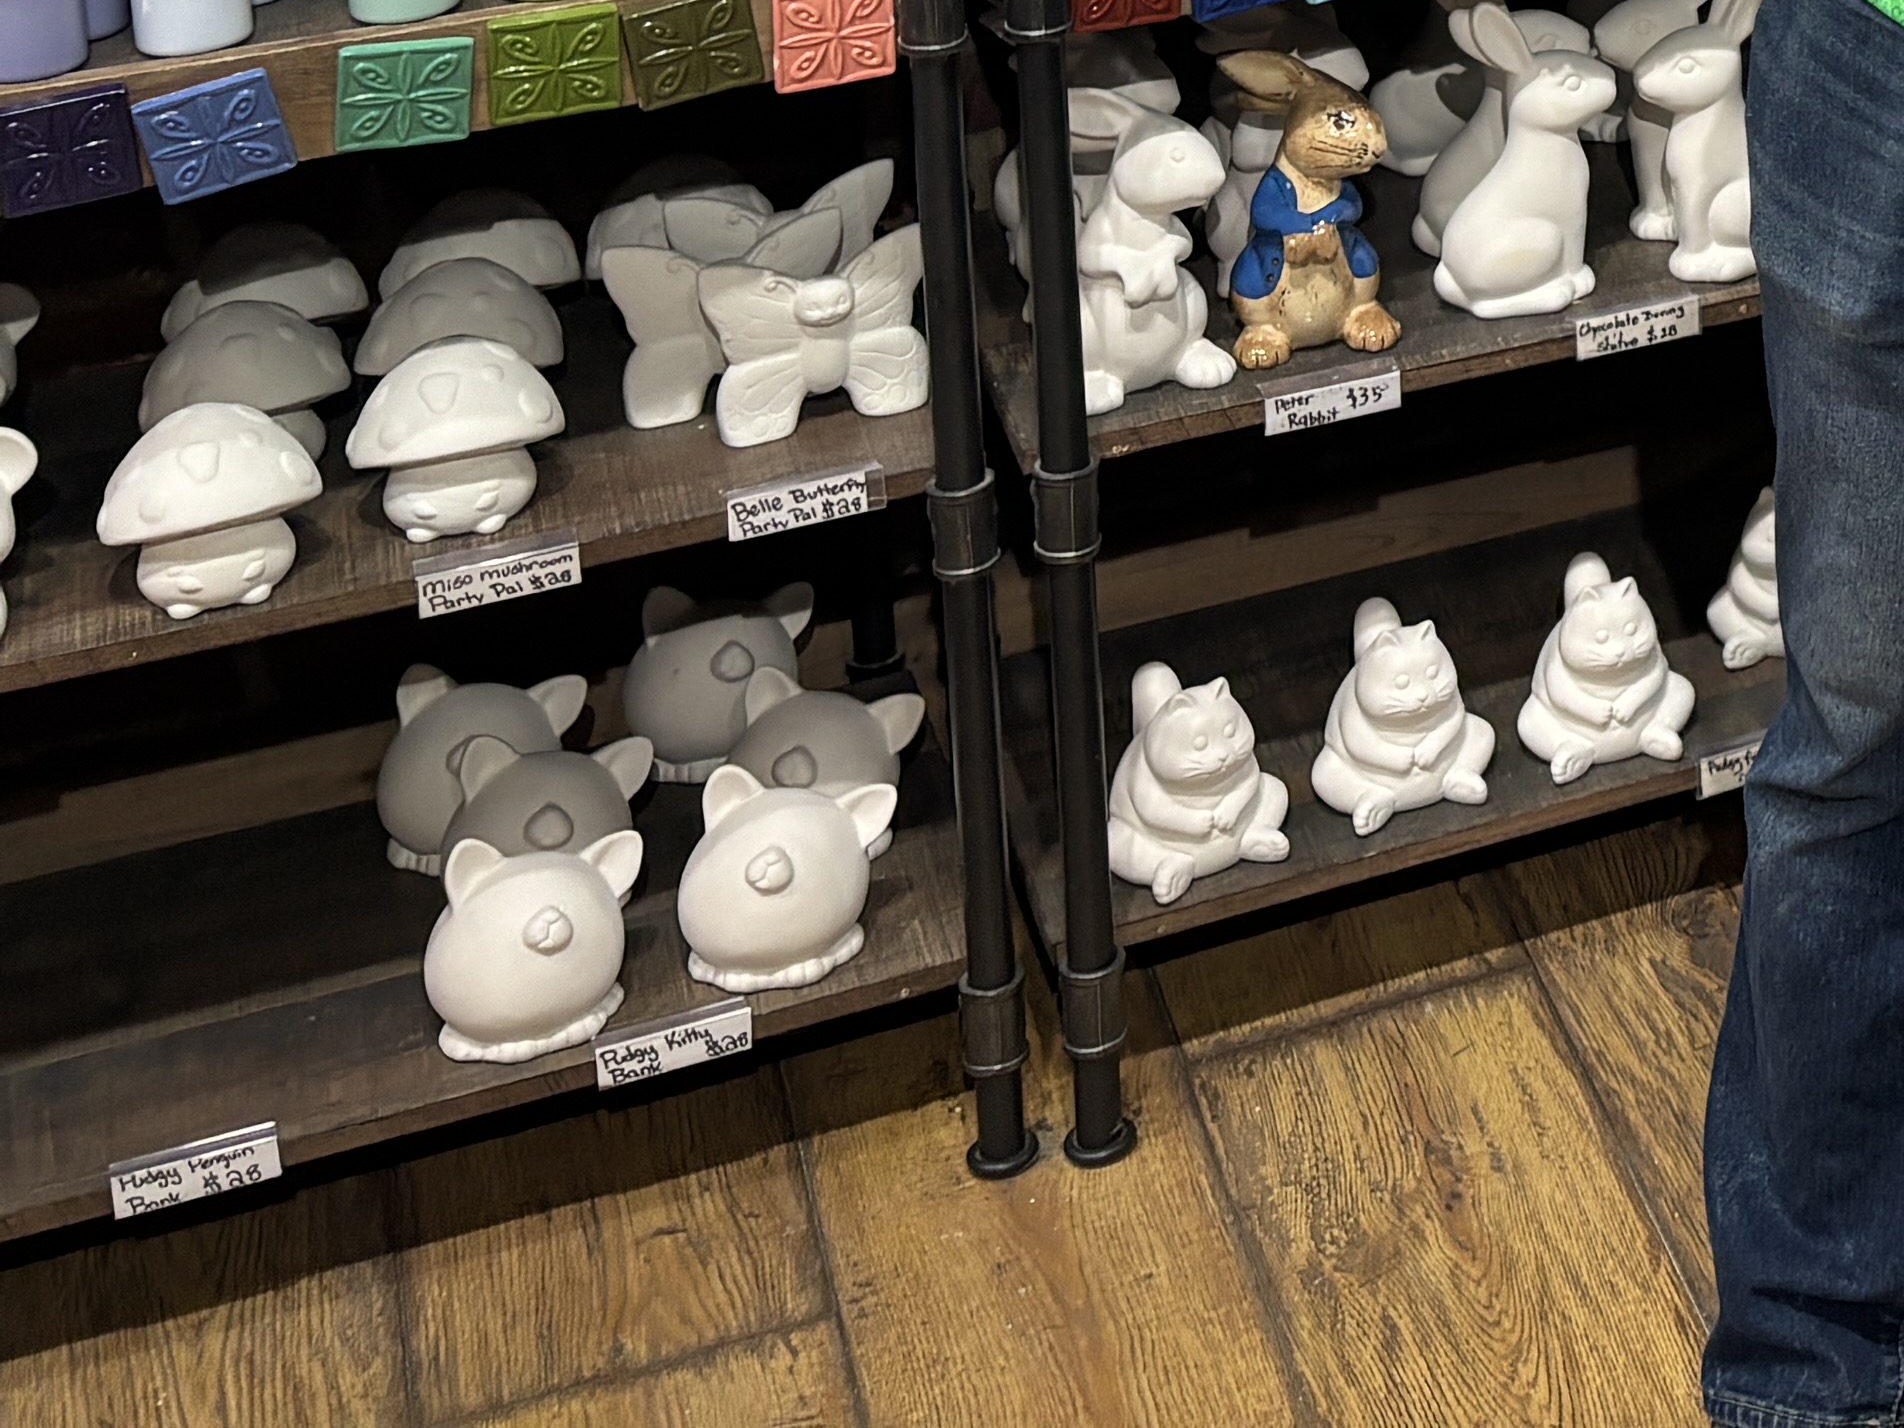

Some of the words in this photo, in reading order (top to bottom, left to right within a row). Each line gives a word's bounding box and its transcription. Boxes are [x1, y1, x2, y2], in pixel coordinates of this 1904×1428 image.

[1287, 406, 1341, 430] Rabbit
[731, 496, 784, 523] Belle
[793, 506, 819, 526] Pal
[428, 592, 483, 612] Party
[489, 582, 523, 598] Pal
[599, 1045, 659, 1069] Pudgy
[664, 1028, 713, 1052] Kitty
[607, 1062, 663, 1084] Bank
